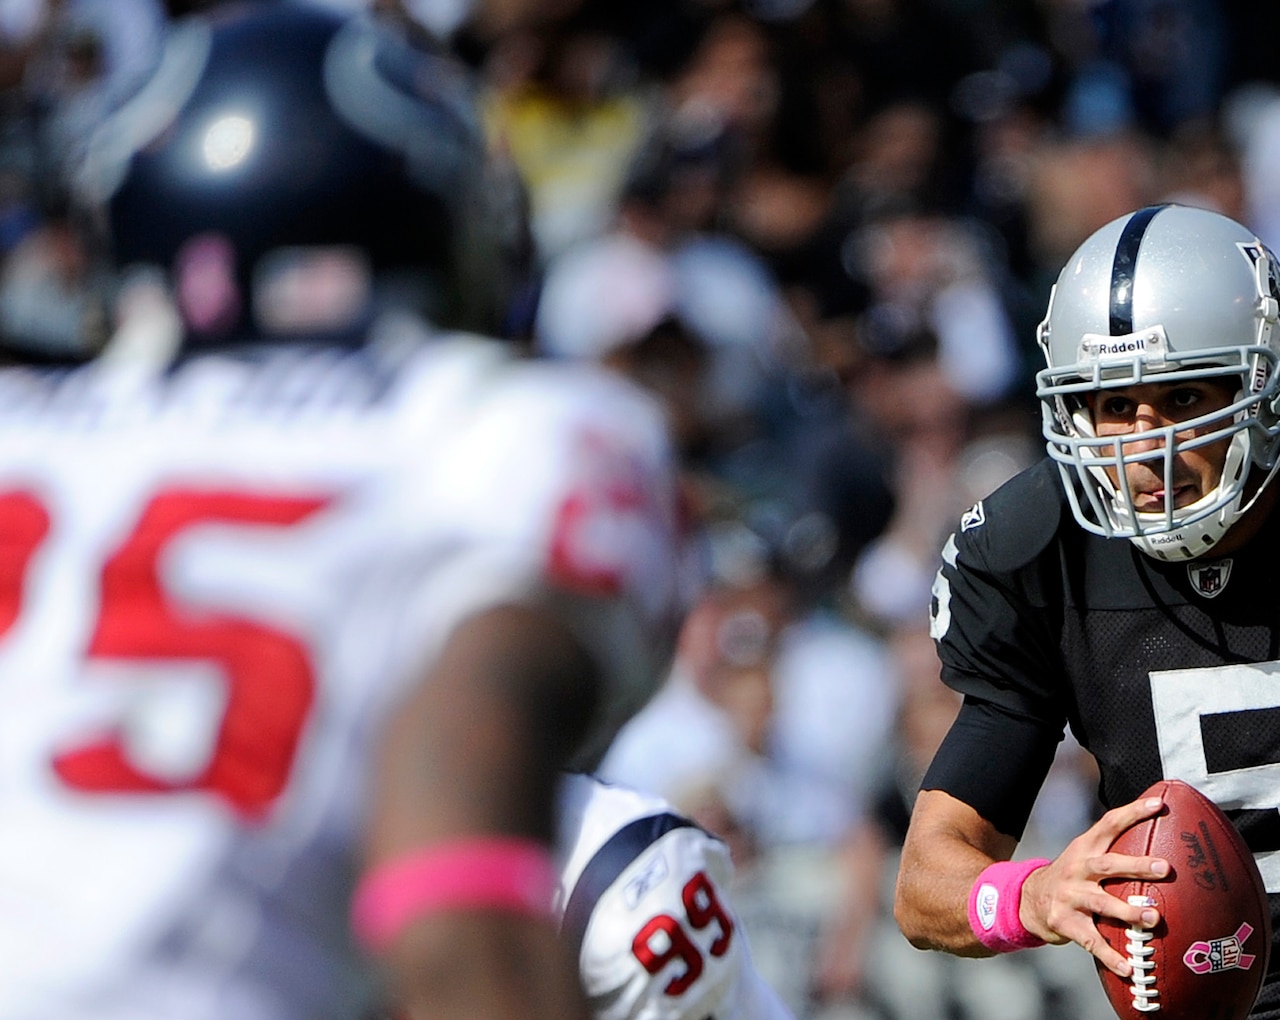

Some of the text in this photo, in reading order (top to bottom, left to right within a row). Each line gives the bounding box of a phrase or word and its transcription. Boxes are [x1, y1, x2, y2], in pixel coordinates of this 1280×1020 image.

[1099, 339, 1145, 354] Riddell
[632, 871, 734, 996] 99
[1222, 939, 1238, 968] NFL
